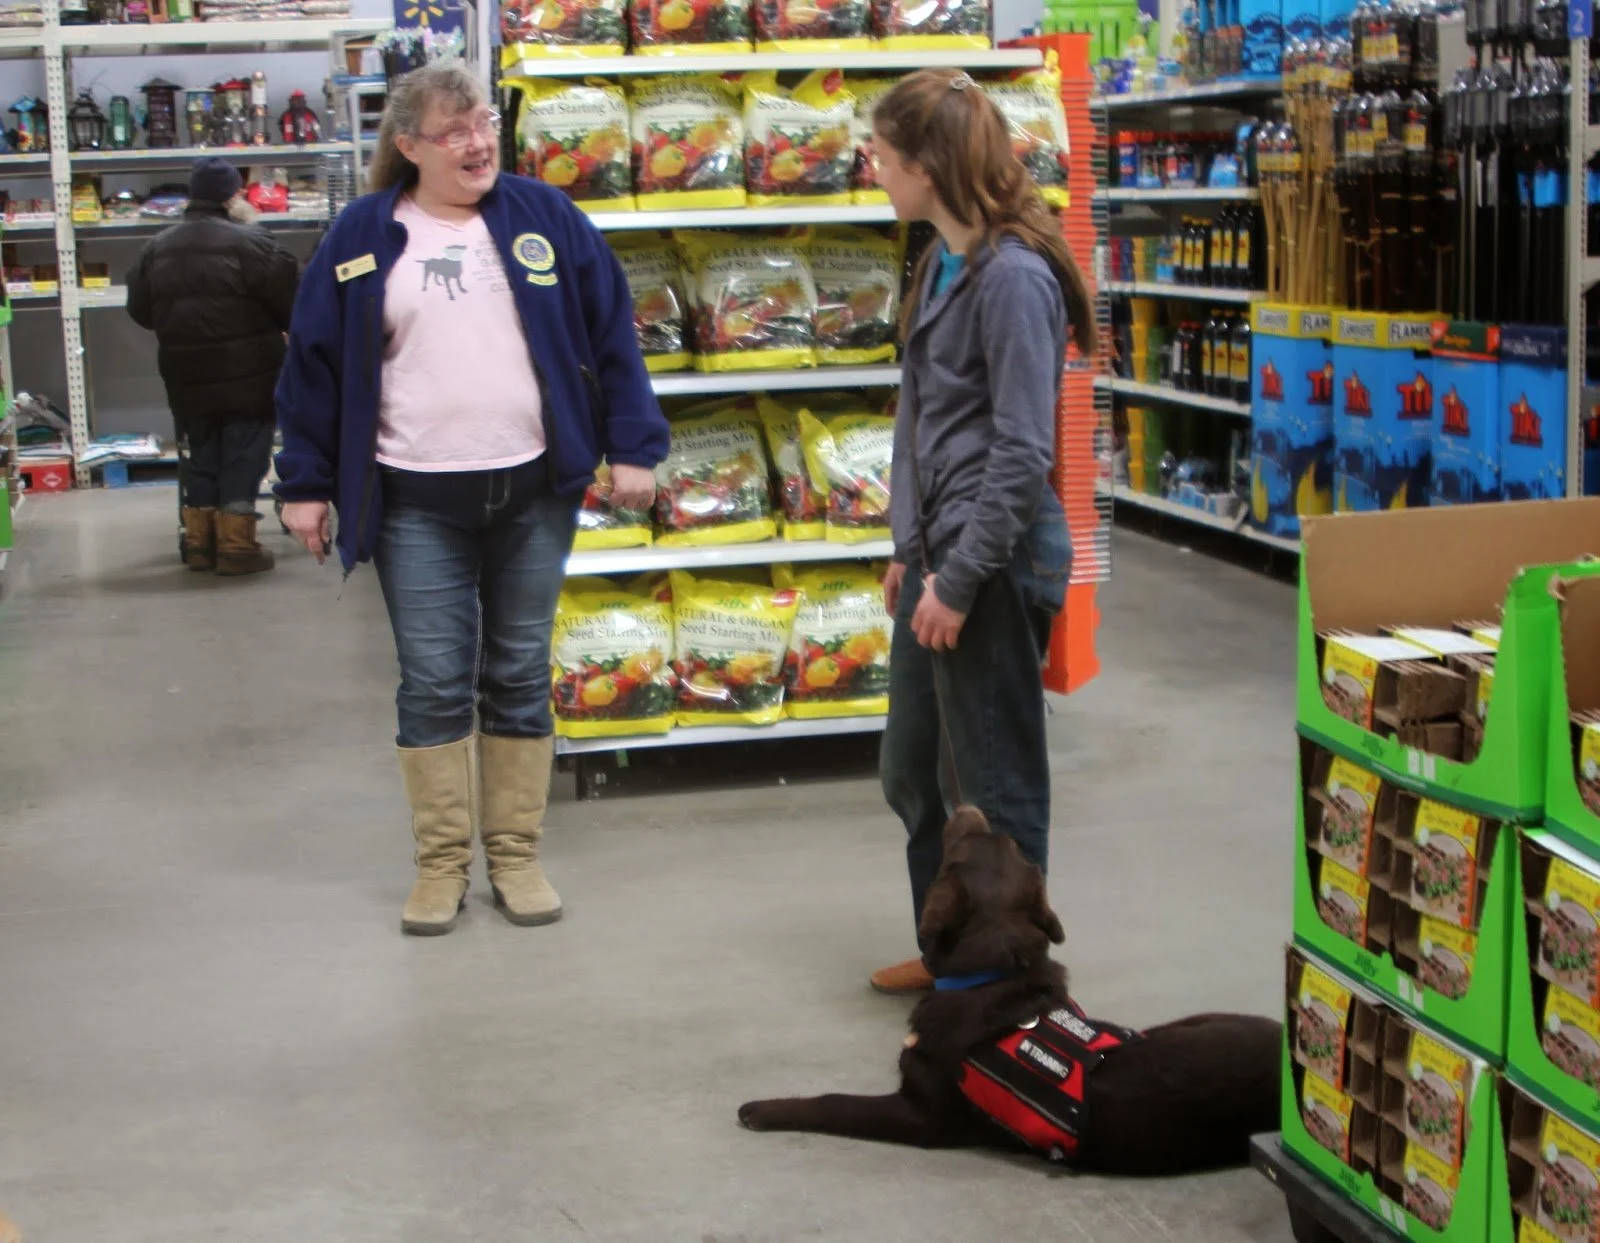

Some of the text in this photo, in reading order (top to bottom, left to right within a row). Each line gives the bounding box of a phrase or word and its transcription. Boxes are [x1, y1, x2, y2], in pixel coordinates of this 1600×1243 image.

[725, 615, 736, 625] &
[821, 606, 867, 622] Starting
[566, 629, 594, 640] Seed
[680, 623, 781, 643] Seed Starting Mix
